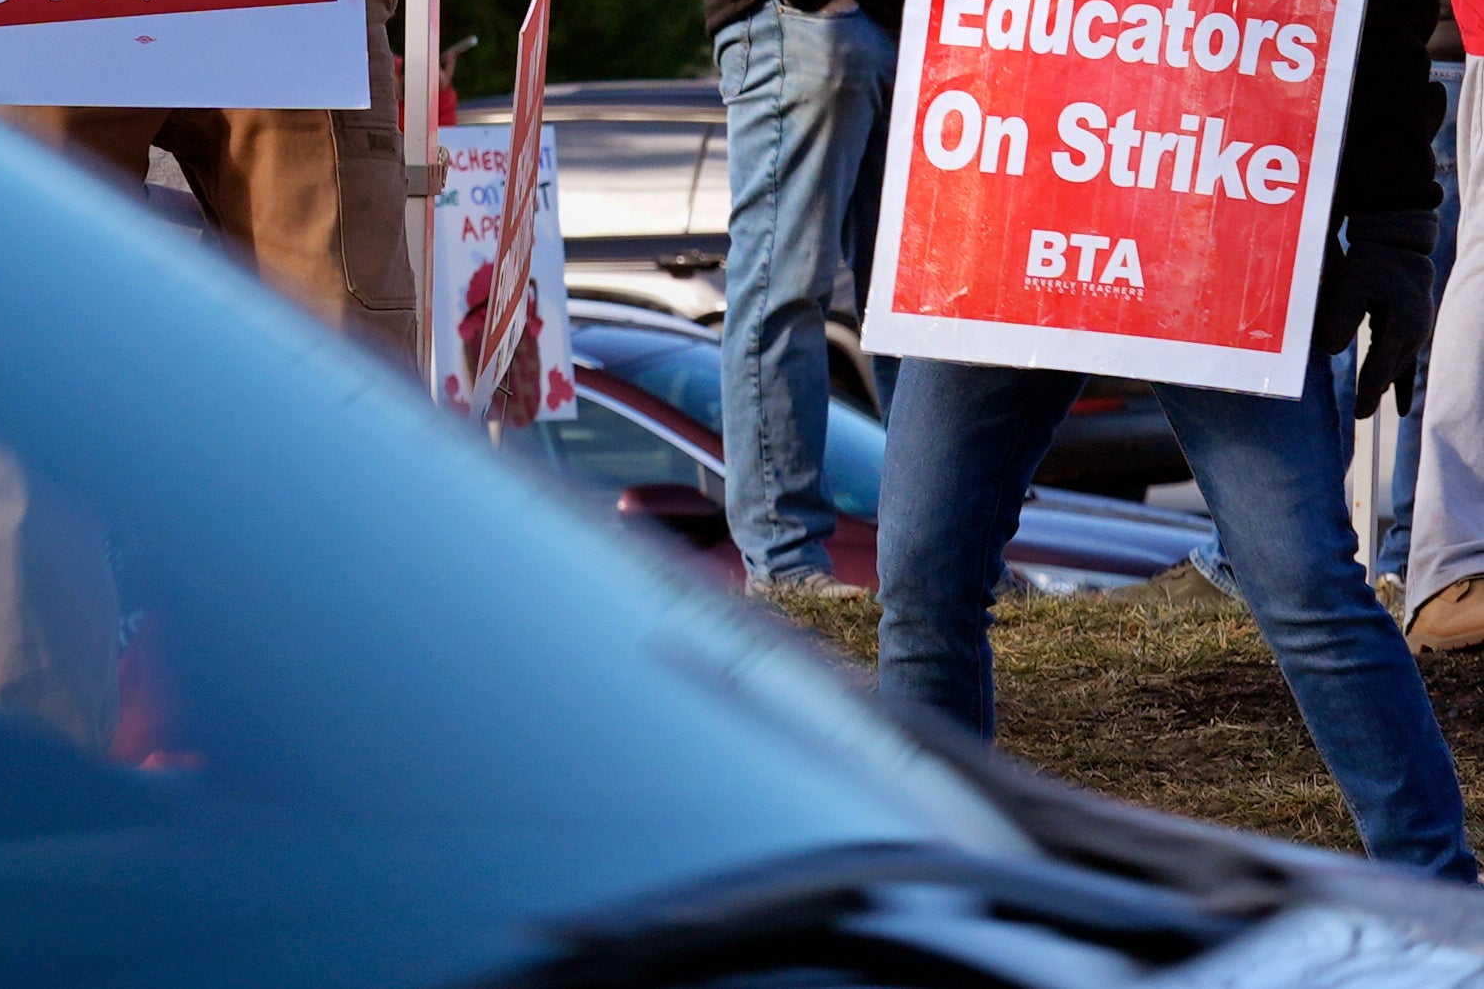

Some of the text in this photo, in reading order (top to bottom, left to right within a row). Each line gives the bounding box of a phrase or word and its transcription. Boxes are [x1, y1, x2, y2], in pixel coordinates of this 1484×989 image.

[922, 89, 1302, 205] On Strike
[1025, 228, 1145, 289] BTA
